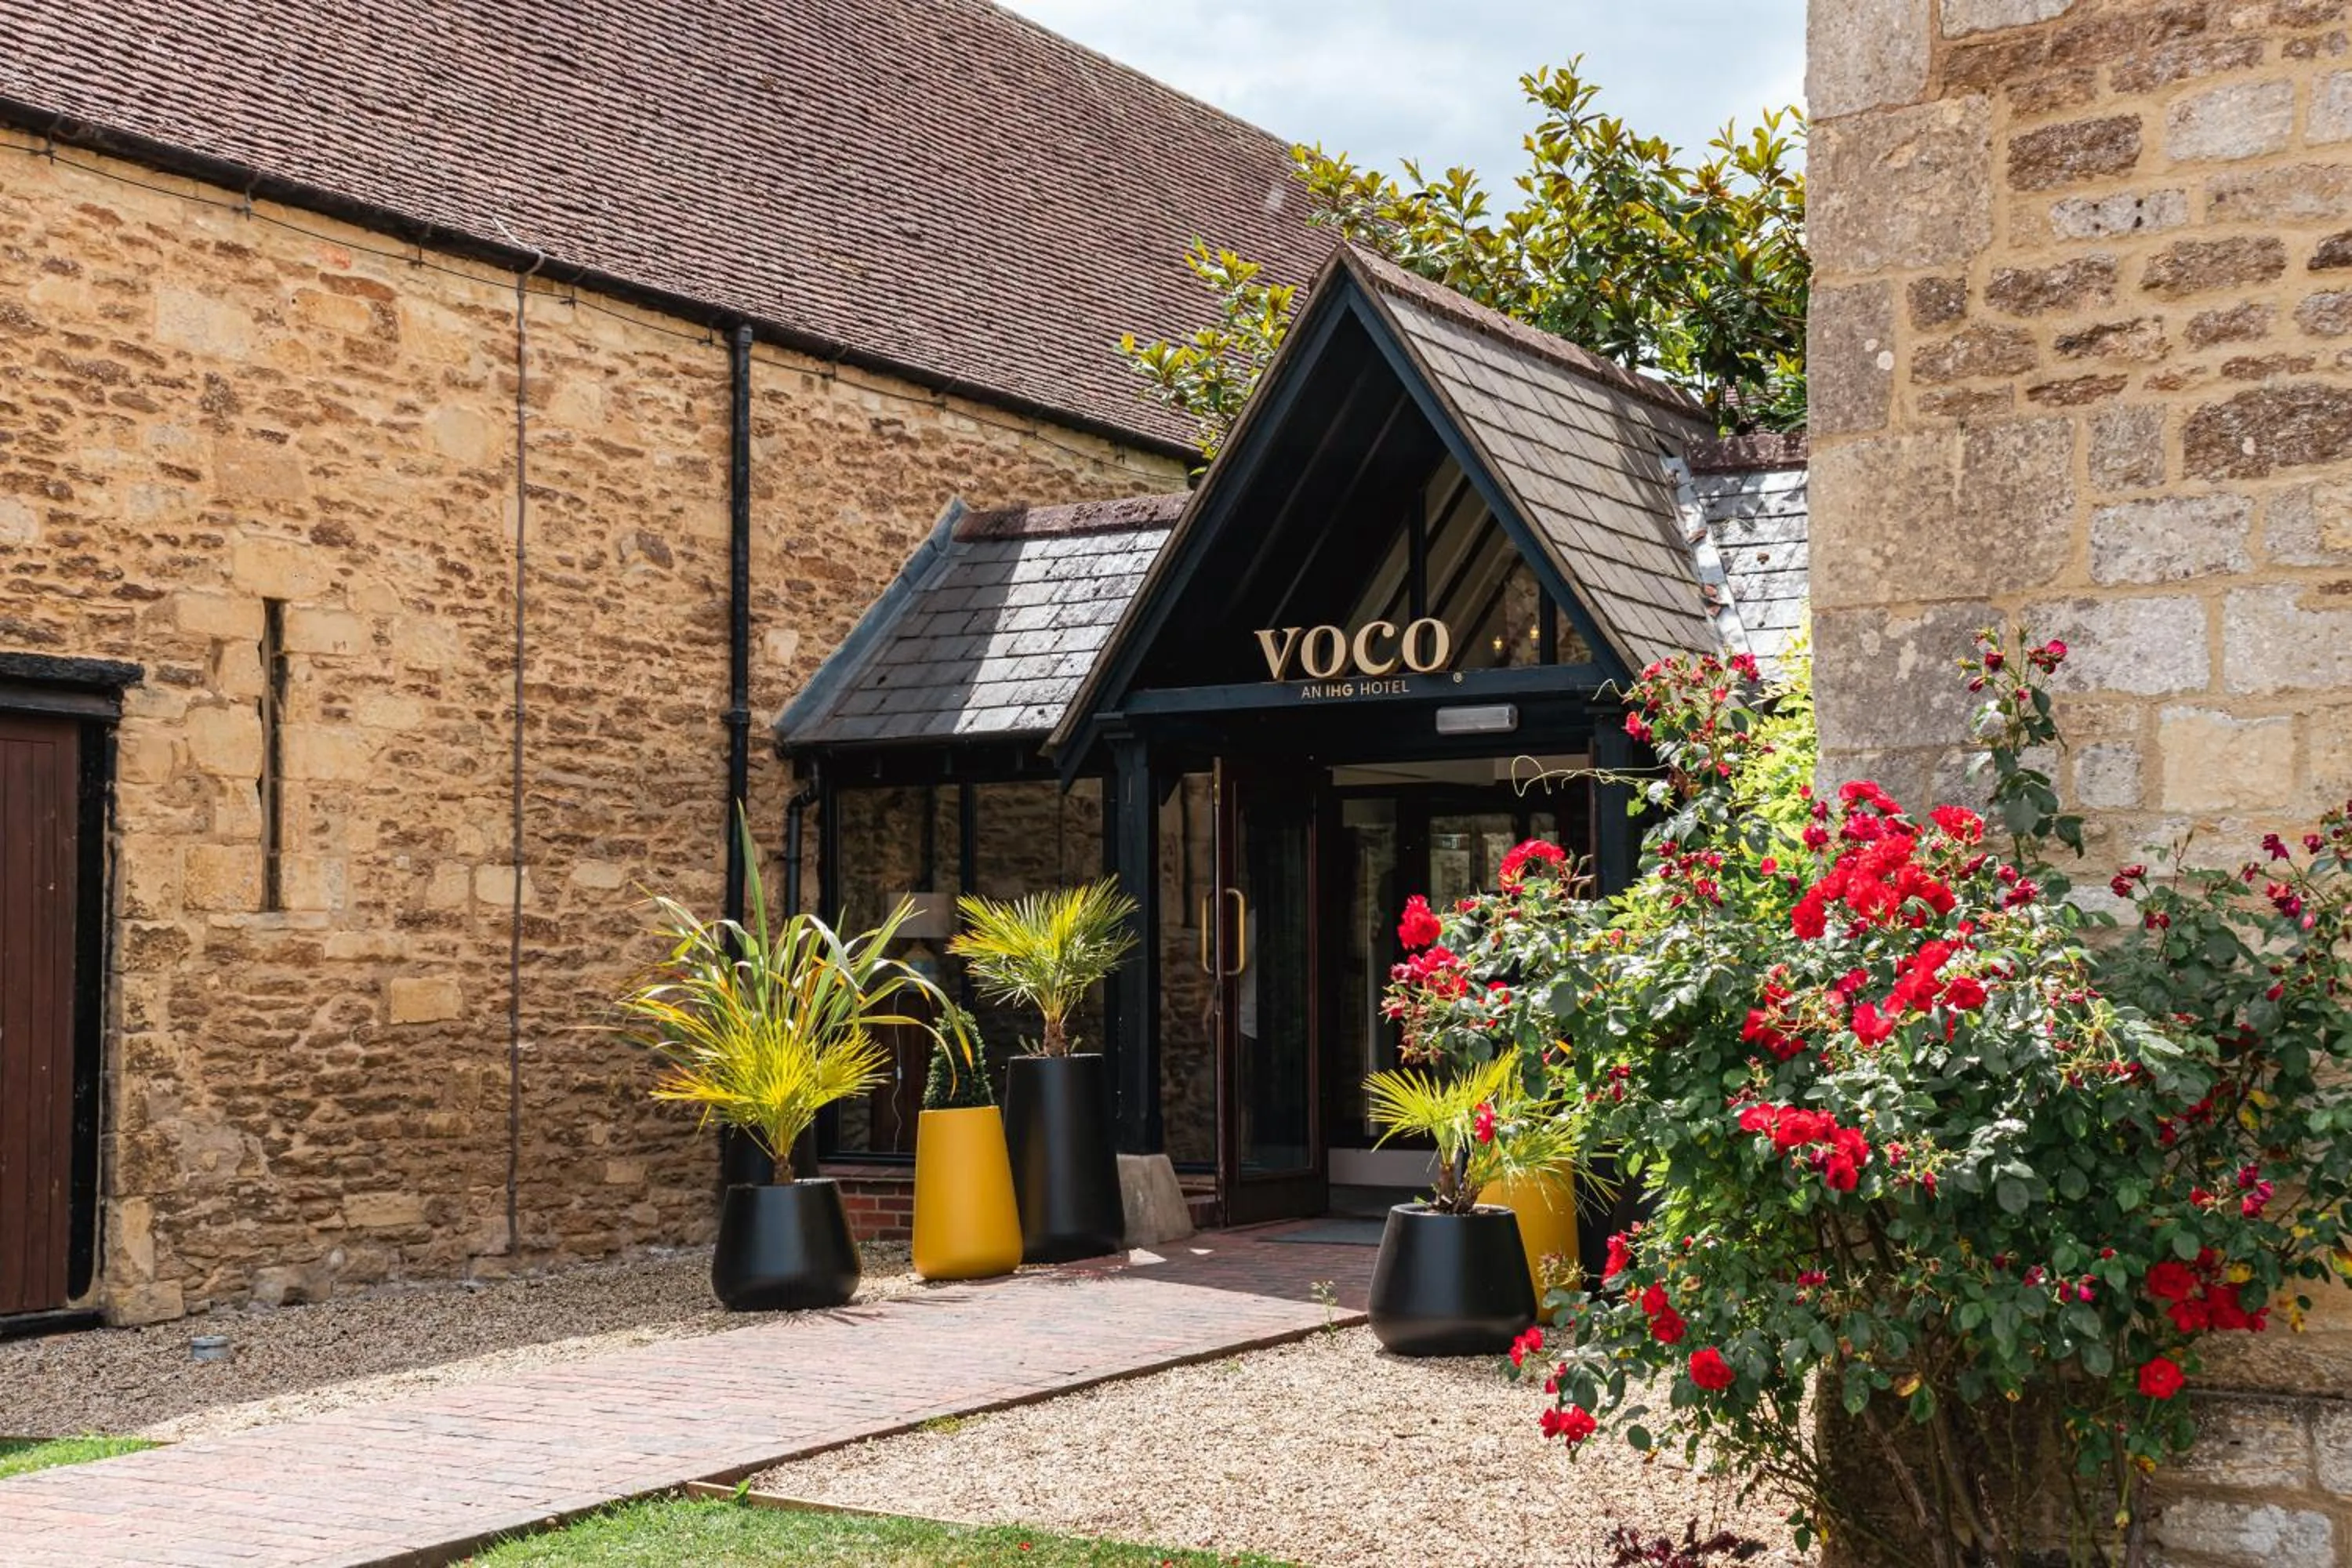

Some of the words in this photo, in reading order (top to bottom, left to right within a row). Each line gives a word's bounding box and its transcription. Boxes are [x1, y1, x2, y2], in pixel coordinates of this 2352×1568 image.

[1301, 685, 1322, 699] AN
[1326, 684, 1354, 697] IHG
[1360, 680, 1410, 695] HOTEL
